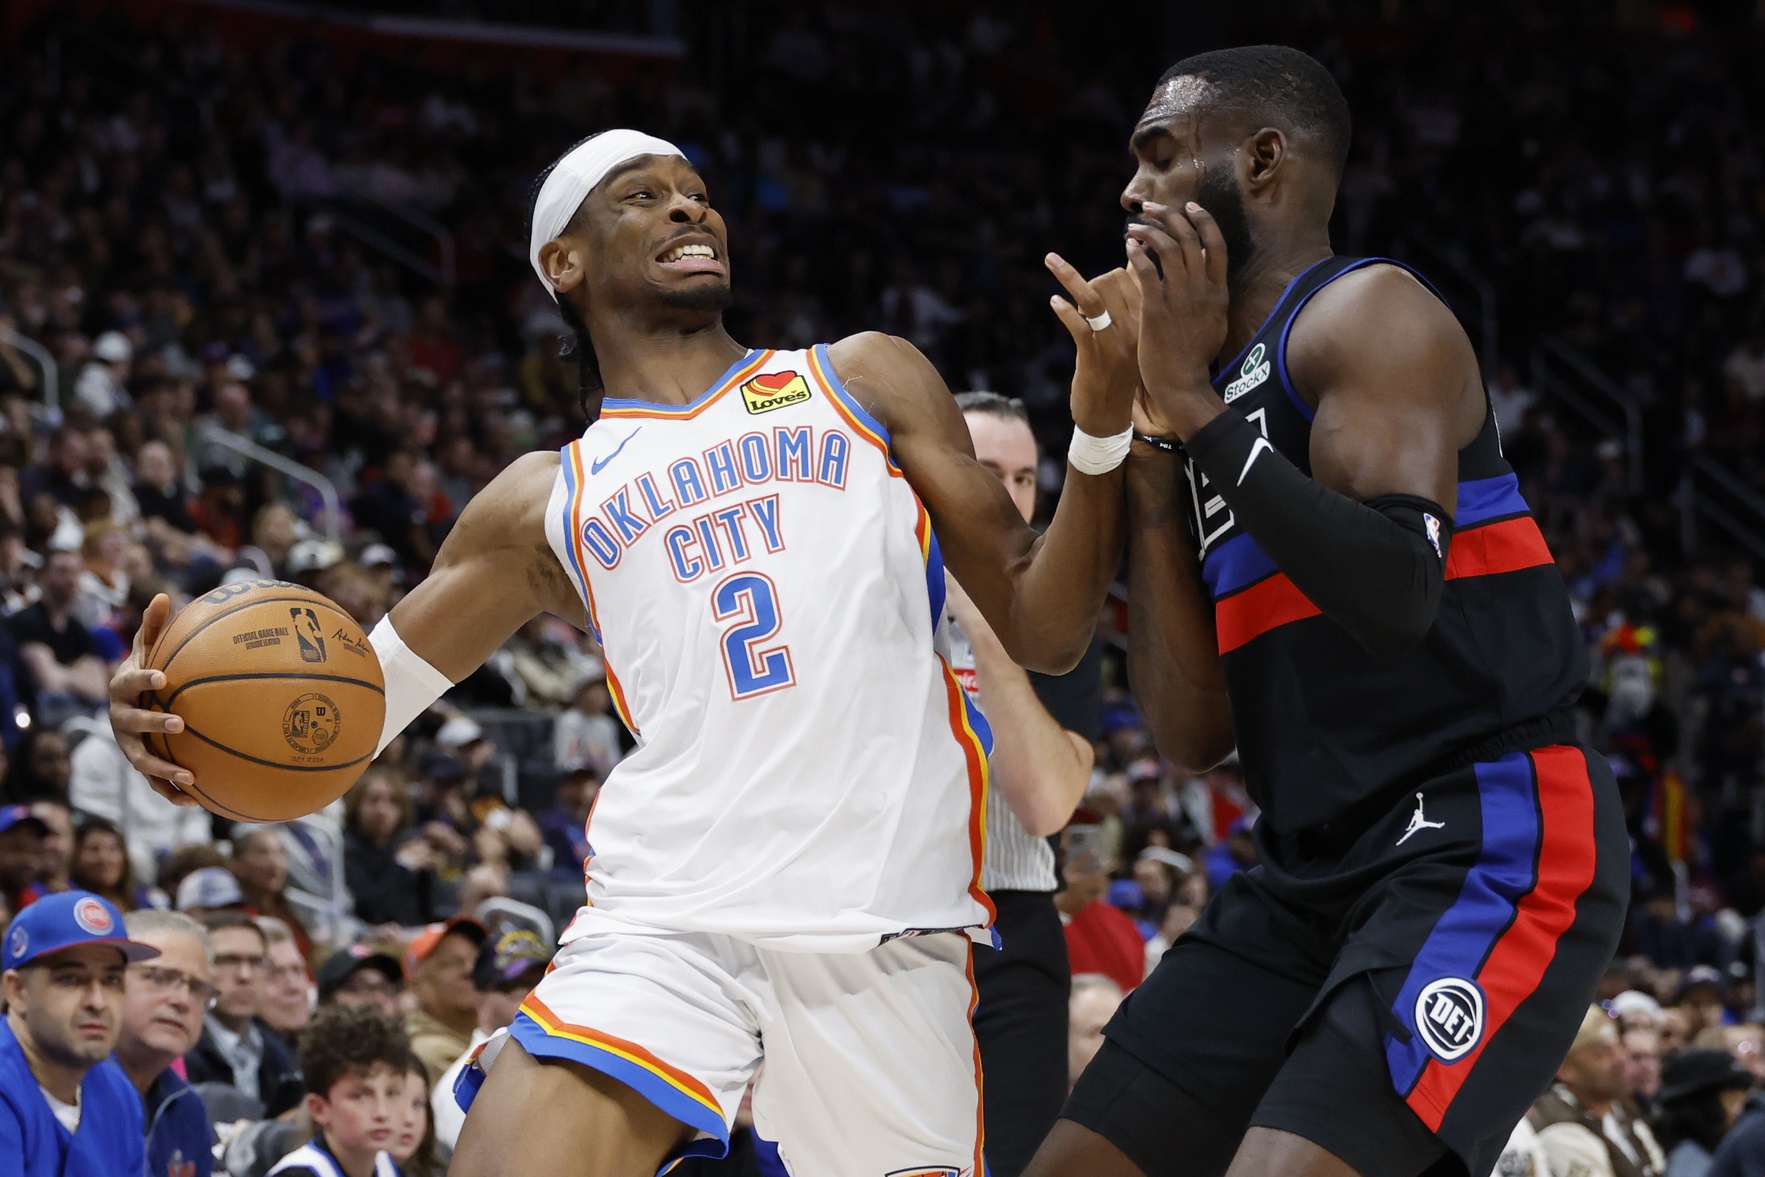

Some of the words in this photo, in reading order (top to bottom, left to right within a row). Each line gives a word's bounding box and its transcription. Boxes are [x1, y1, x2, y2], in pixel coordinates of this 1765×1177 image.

[580, 426, 851, 571] OKLAHOMA
[664, 493, 786, 584] CITY
[711, 571, 797, 701] 2
[1429, 992, 1474, 1043] DET
